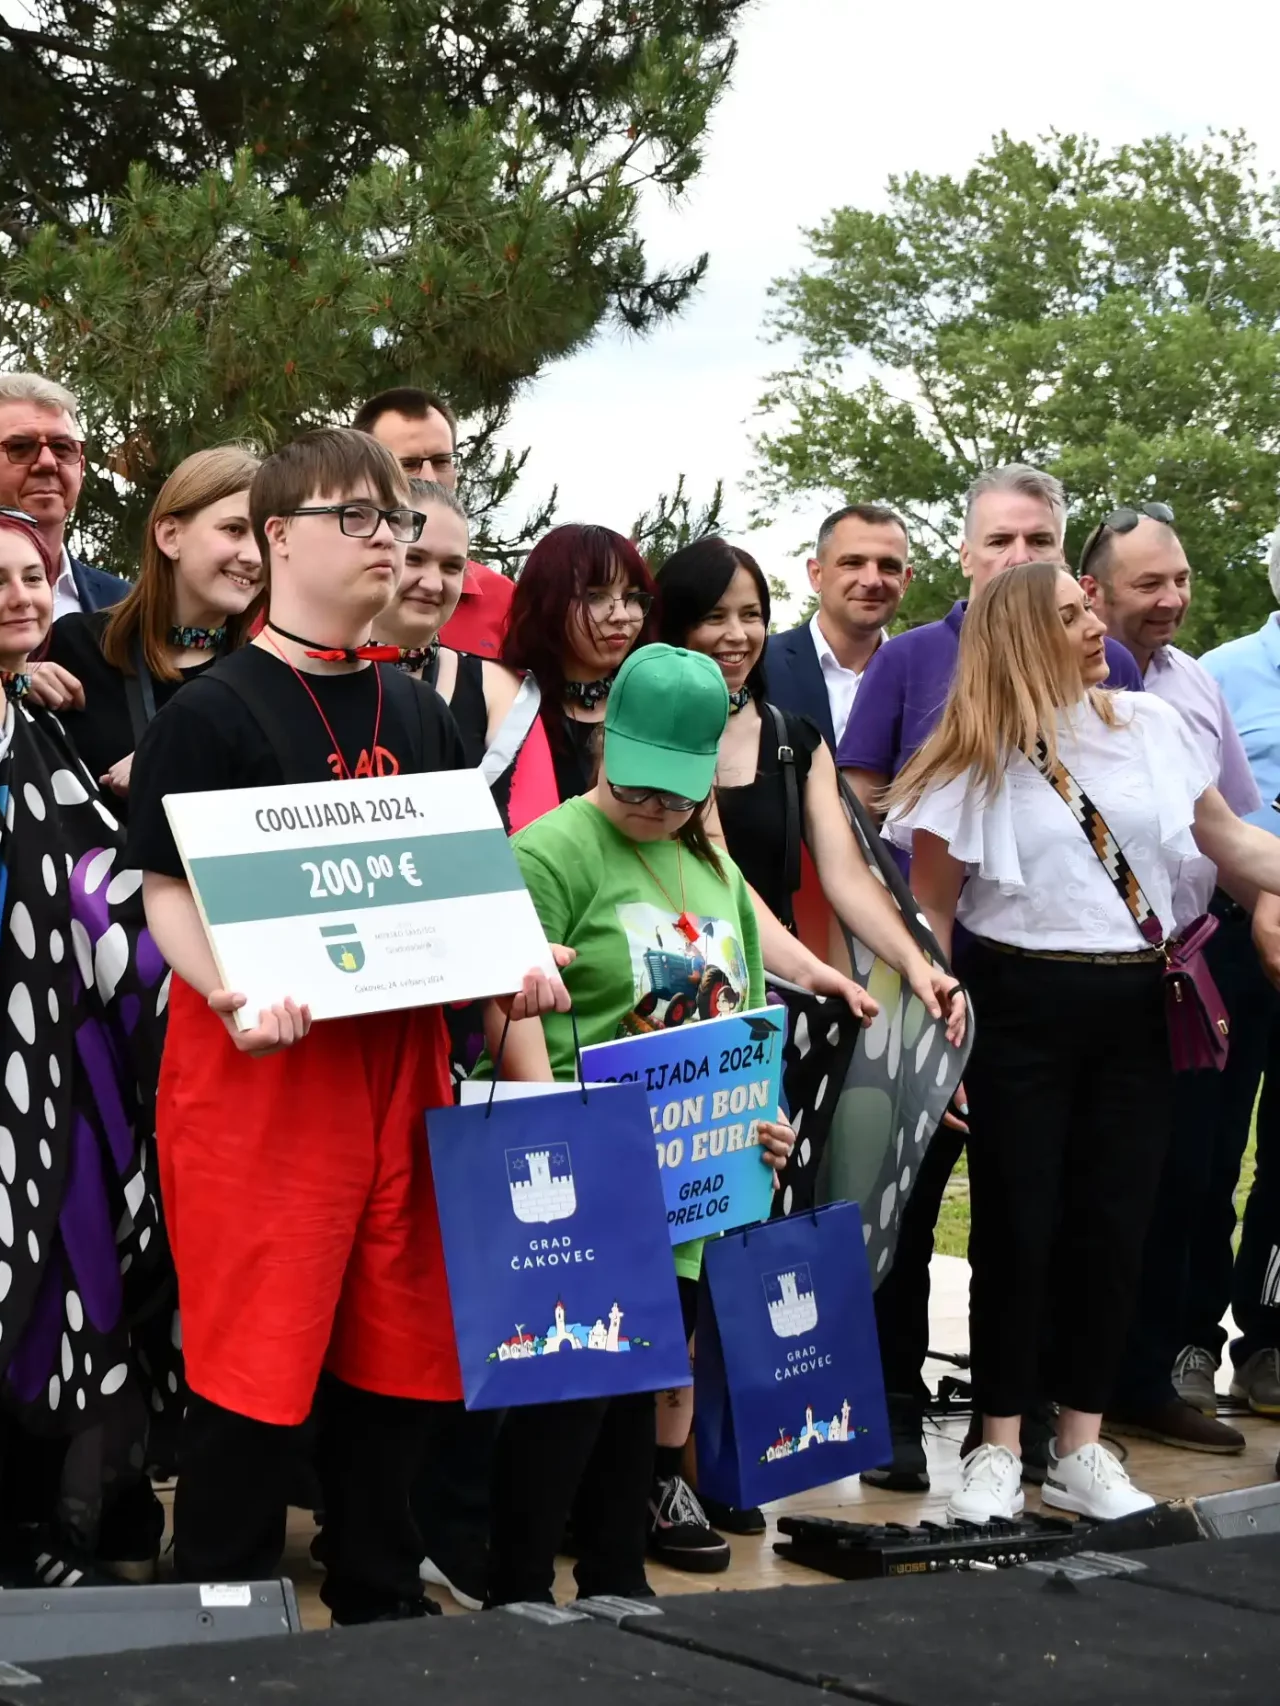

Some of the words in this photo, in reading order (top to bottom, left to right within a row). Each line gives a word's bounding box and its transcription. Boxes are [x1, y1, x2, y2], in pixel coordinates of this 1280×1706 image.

[255, 801, 365, 833] COOLIJADA
[365, 797, 425, 823] 2024.
[719, 1041, 770, 1074] 2024.
[711, 1079, 770, 1121] BON
[691, 1118, 761, 1163] EURA
[679, 1174, 725, 1201] GRAD
[667, 1195, 730, 1227] PRELOG
[510, 1248, 595, 1270] ČAKOVEC
[529, 1236, 571, 1251] GRAD
[787, 1345, 816, 1362] GRAD
